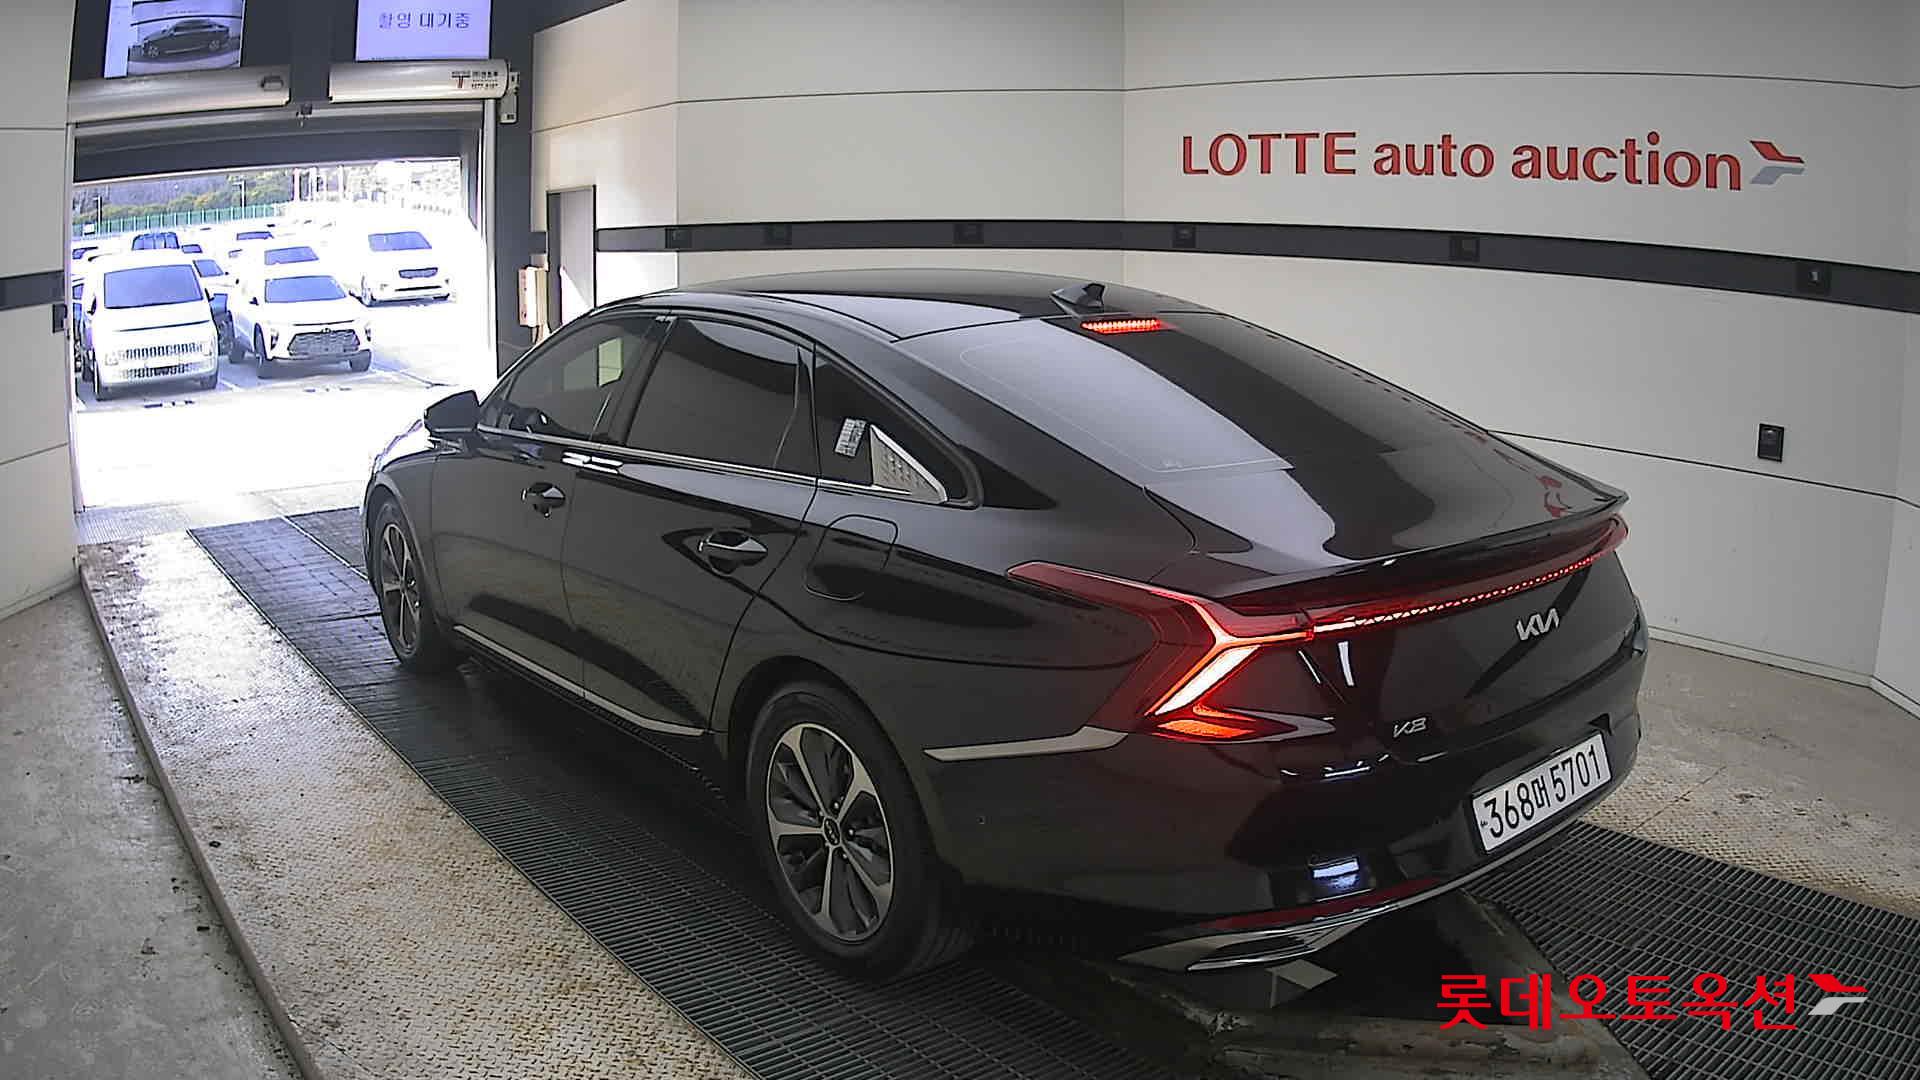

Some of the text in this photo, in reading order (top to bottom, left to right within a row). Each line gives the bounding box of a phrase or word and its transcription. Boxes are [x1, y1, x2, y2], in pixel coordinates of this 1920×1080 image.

[1182, 131, 1742, 191] LOTTE auto auction
[1515, 608, 1560, 641] KIA
[1393, 717, 1427, 738] K8
